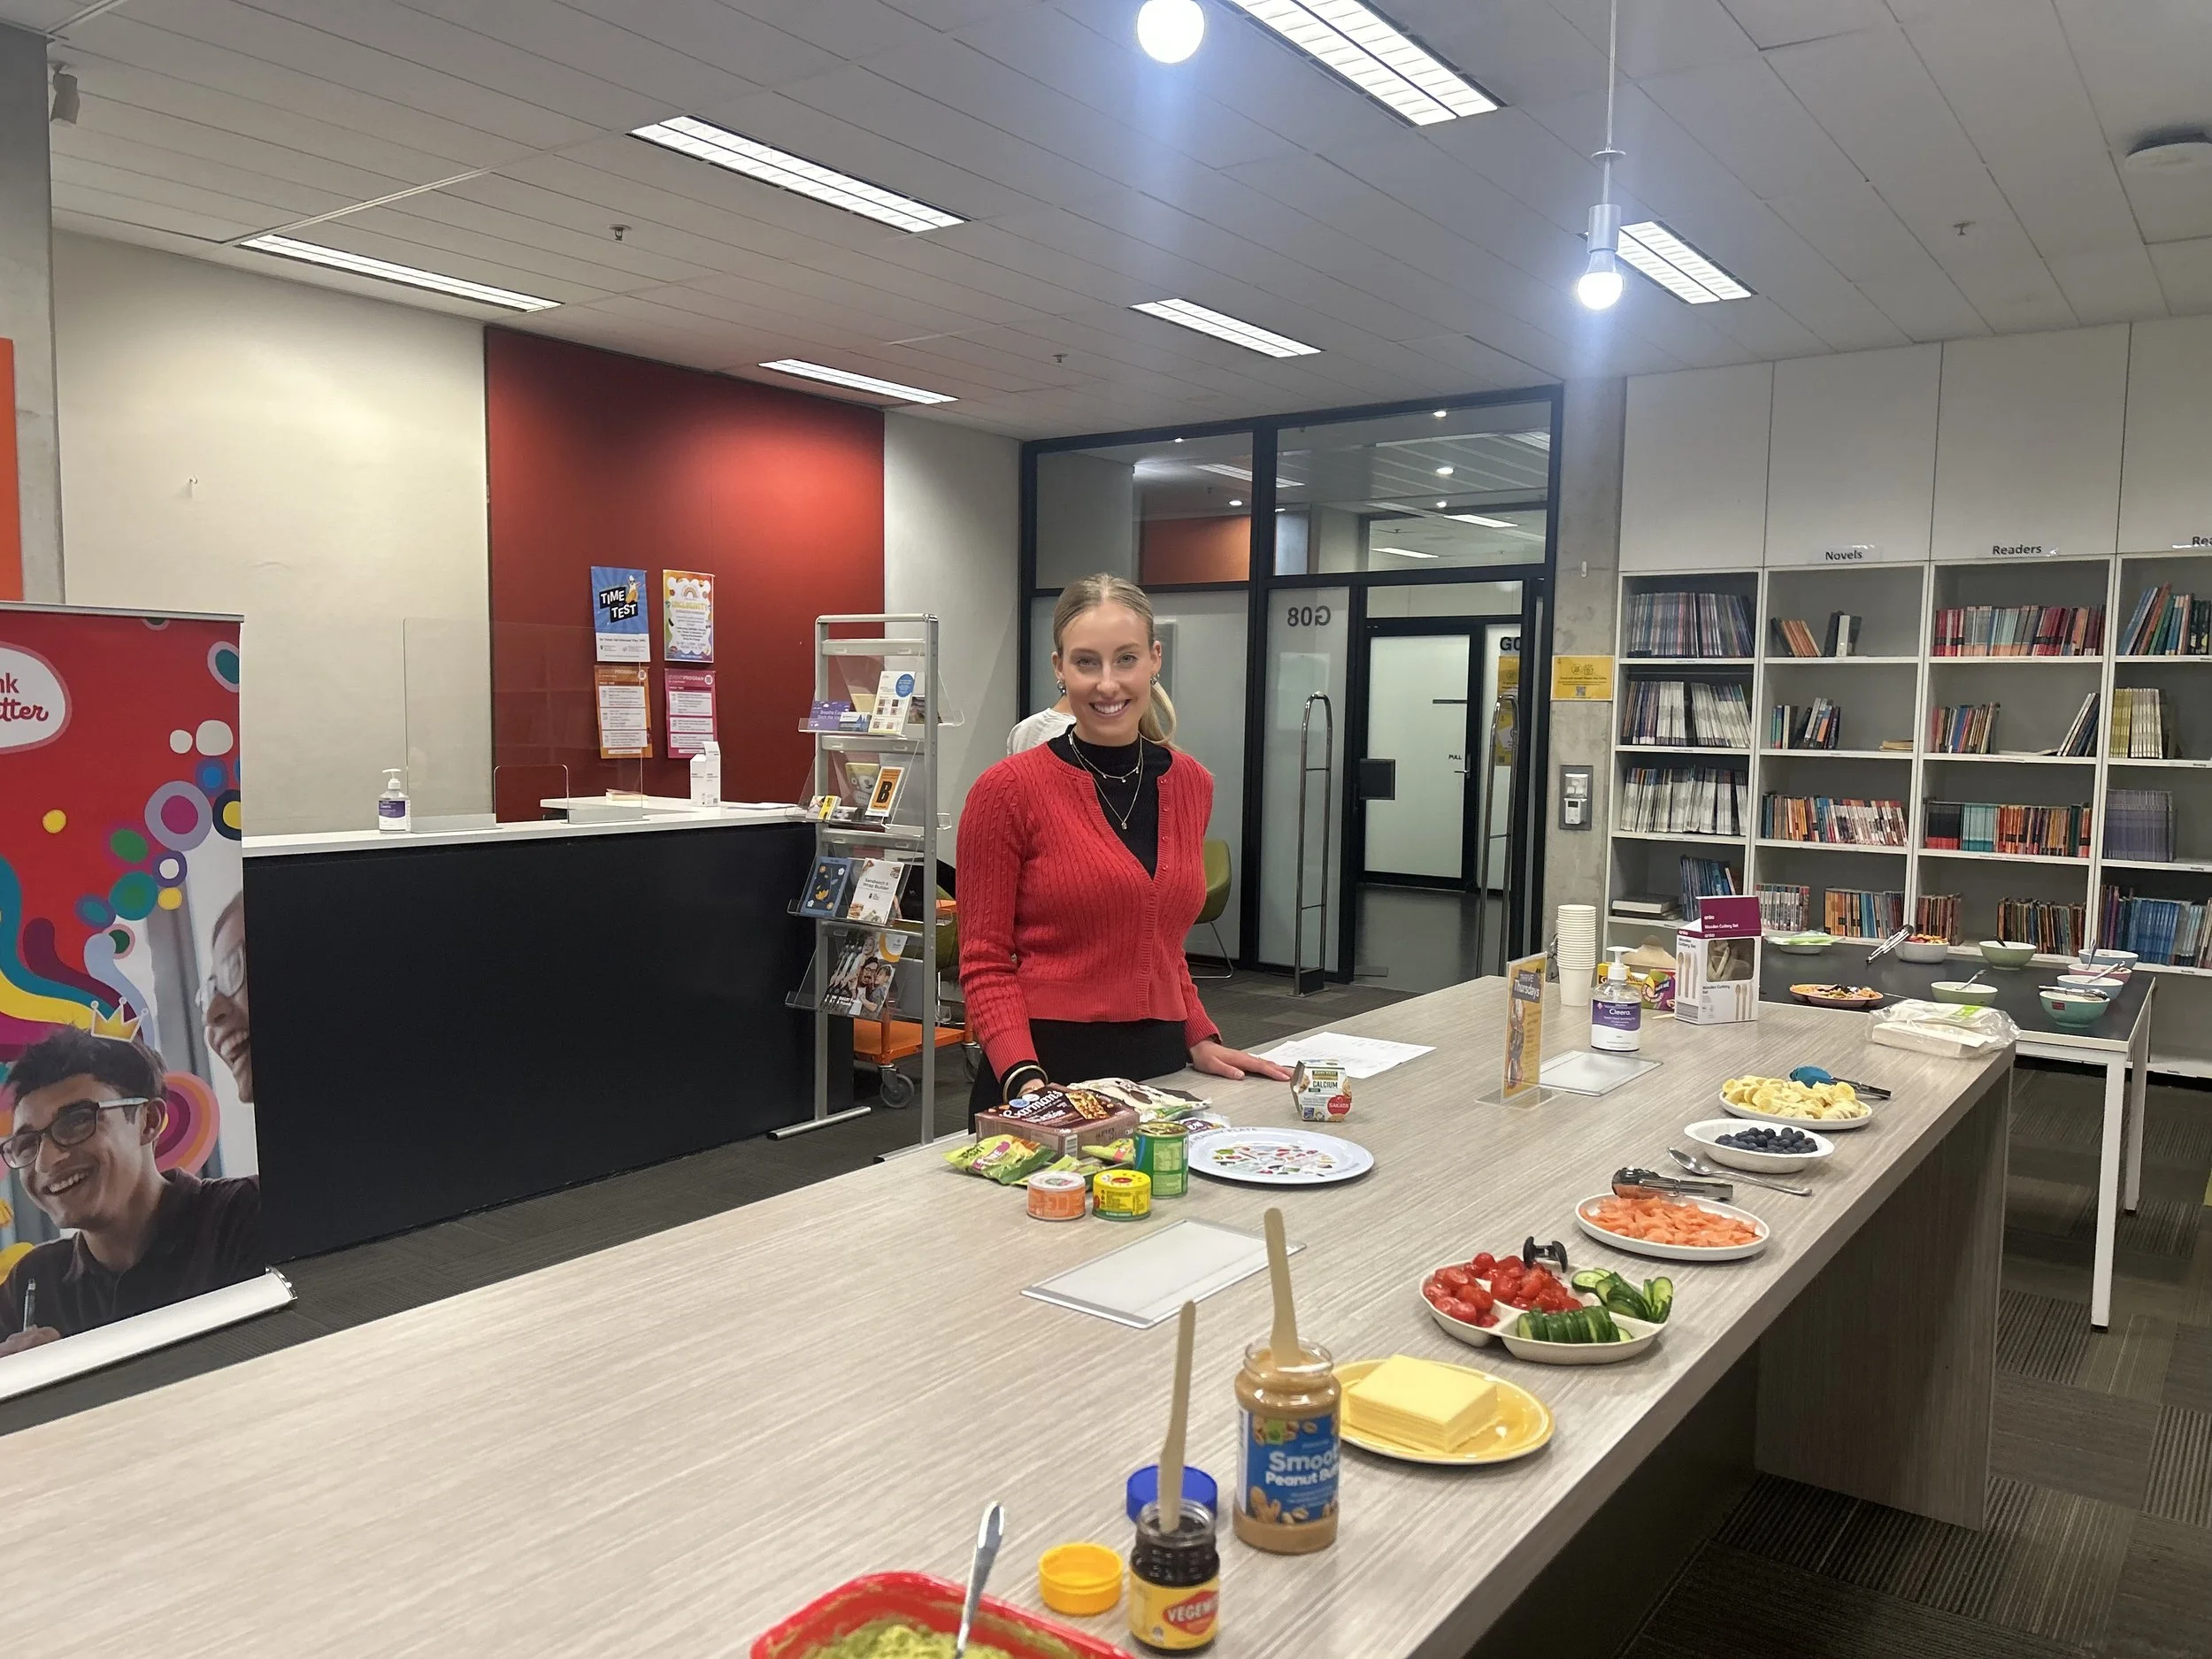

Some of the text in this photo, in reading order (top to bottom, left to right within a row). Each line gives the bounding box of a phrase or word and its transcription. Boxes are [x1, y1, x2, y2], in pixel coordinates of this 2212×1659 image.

[1825, 549, 1863, 561] Novels
[1993, 544, 2042, 556] Readers
[600, 589, 625, 605] TIME
[611, 603, 637, 618] TEST
[0, 696, 50, 722] tter
[1312, 1080, 1338, 1089] CALCIUM
[1265, 1471, 1318, 1486] Peanut
